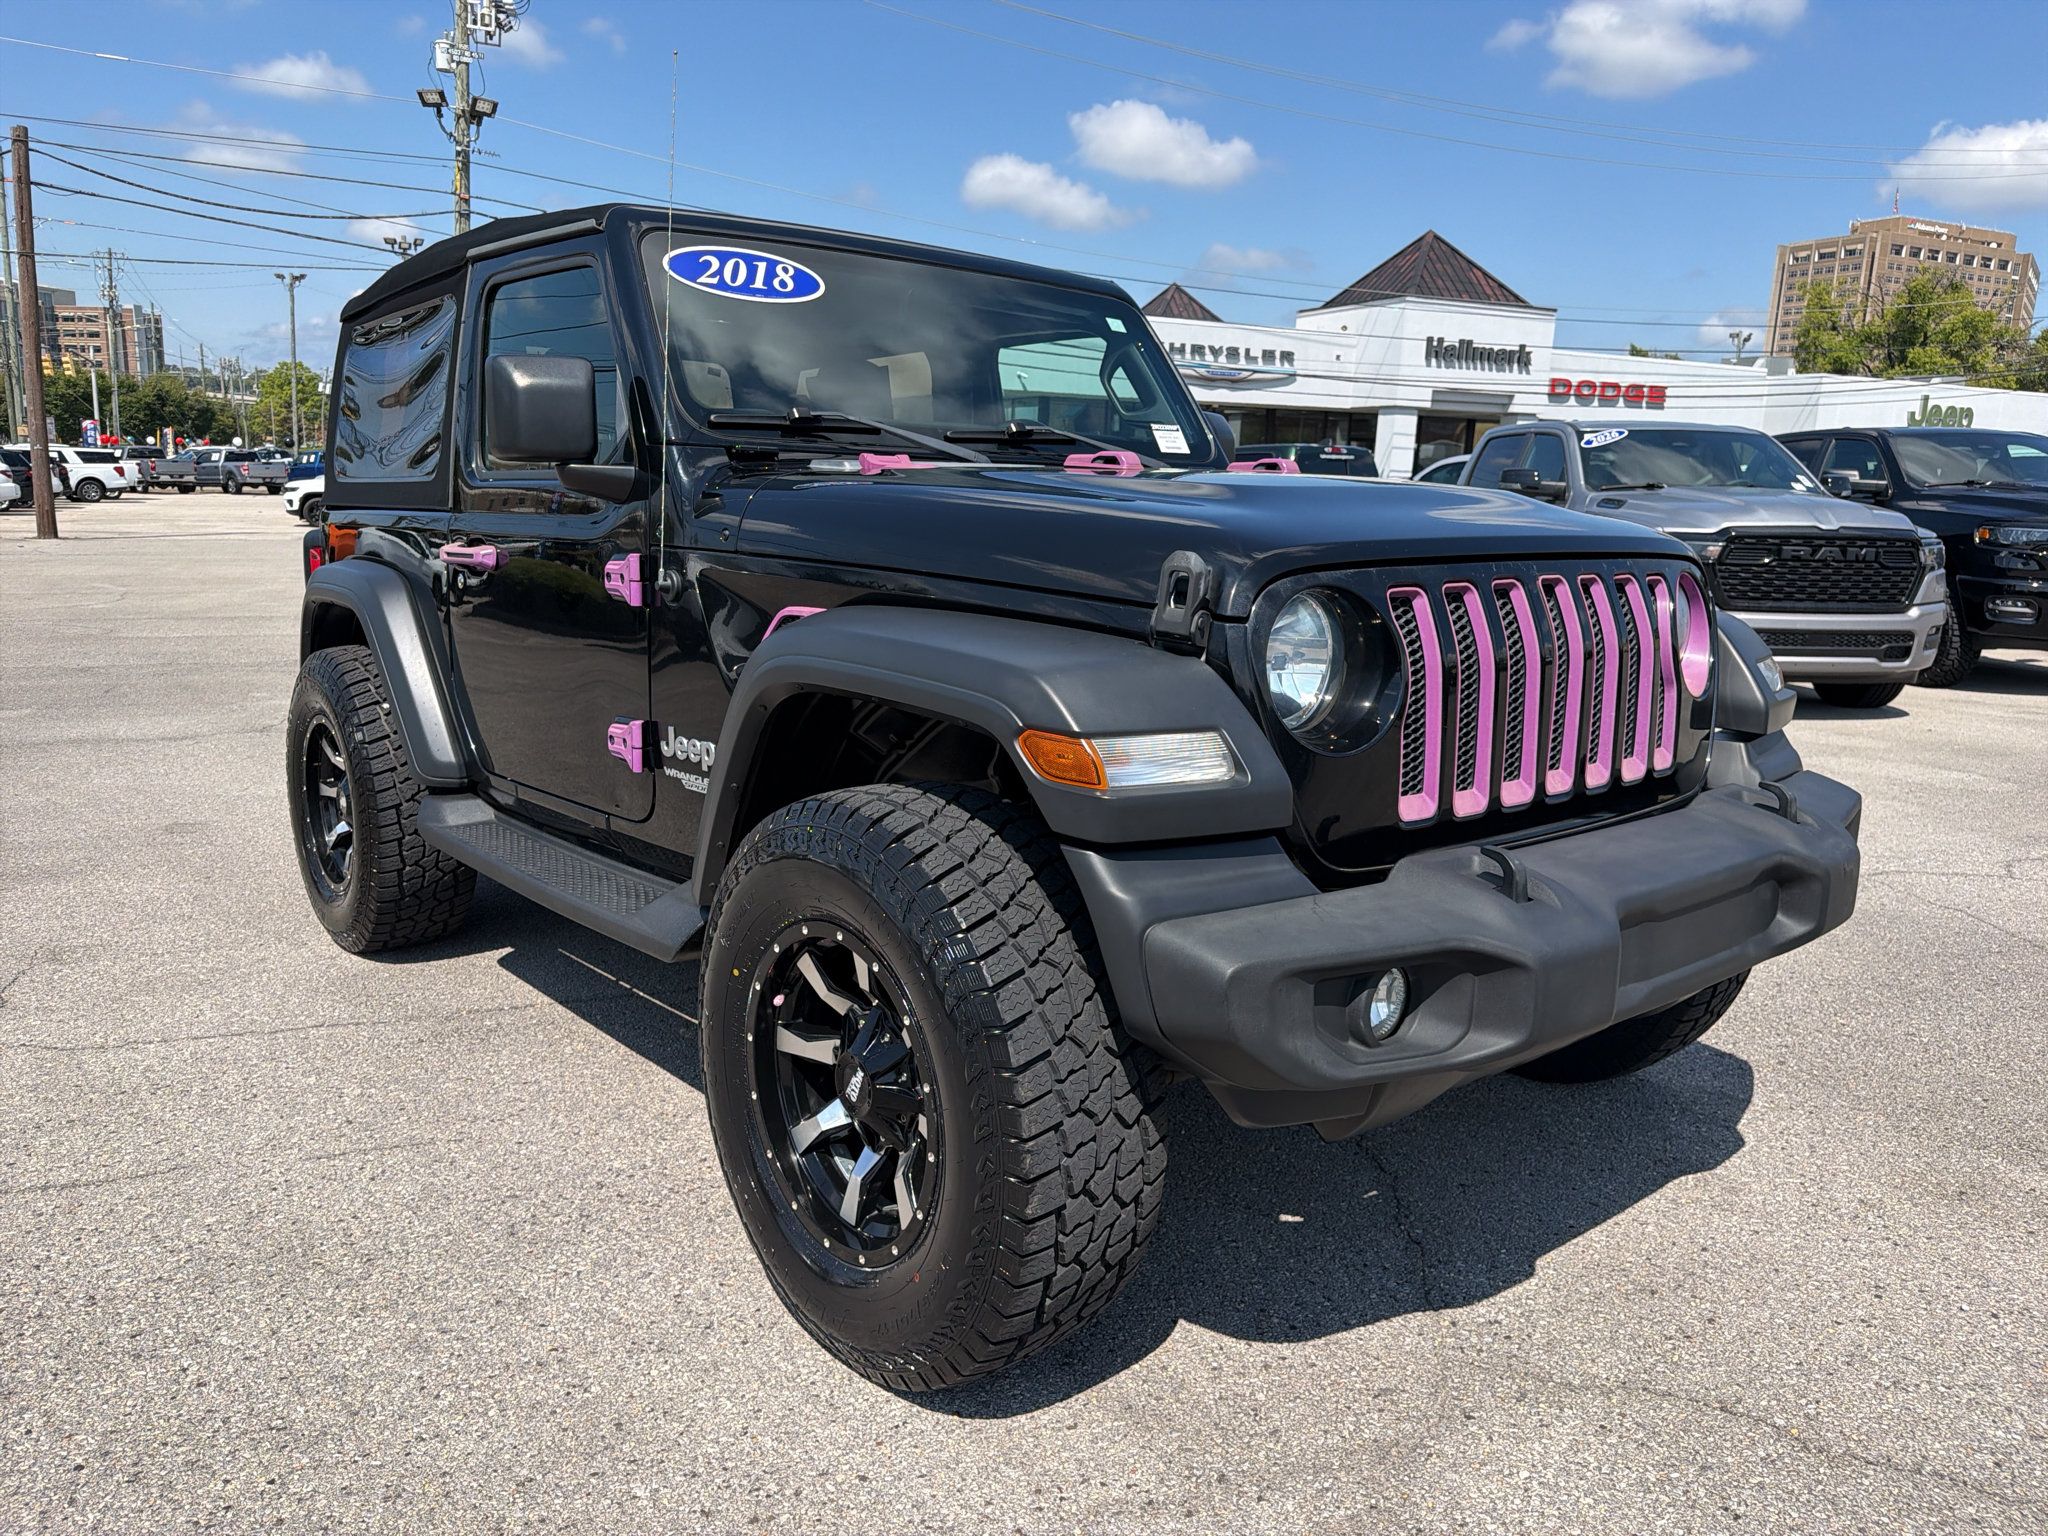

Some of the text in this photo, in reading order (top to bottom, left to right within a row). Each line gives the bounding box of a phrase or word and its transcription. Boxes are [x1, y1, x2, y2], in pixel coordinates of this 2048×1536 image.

[696, 255, 795, 292] 2018
[1162, 342, 1296, 366] HRYSLER
[1425, 336, 1532, 371] Hallmark
[1549, 378, 1667, 403] DODGE
[1907, 395, 1974, 428] Jeep
[1588, 430, 1620, 445] 2026
[1780, 545, 1877, 561] RAM
[660, 726, 716, 772] Jeep
[663, 766, 710, 786] WRANGLE
